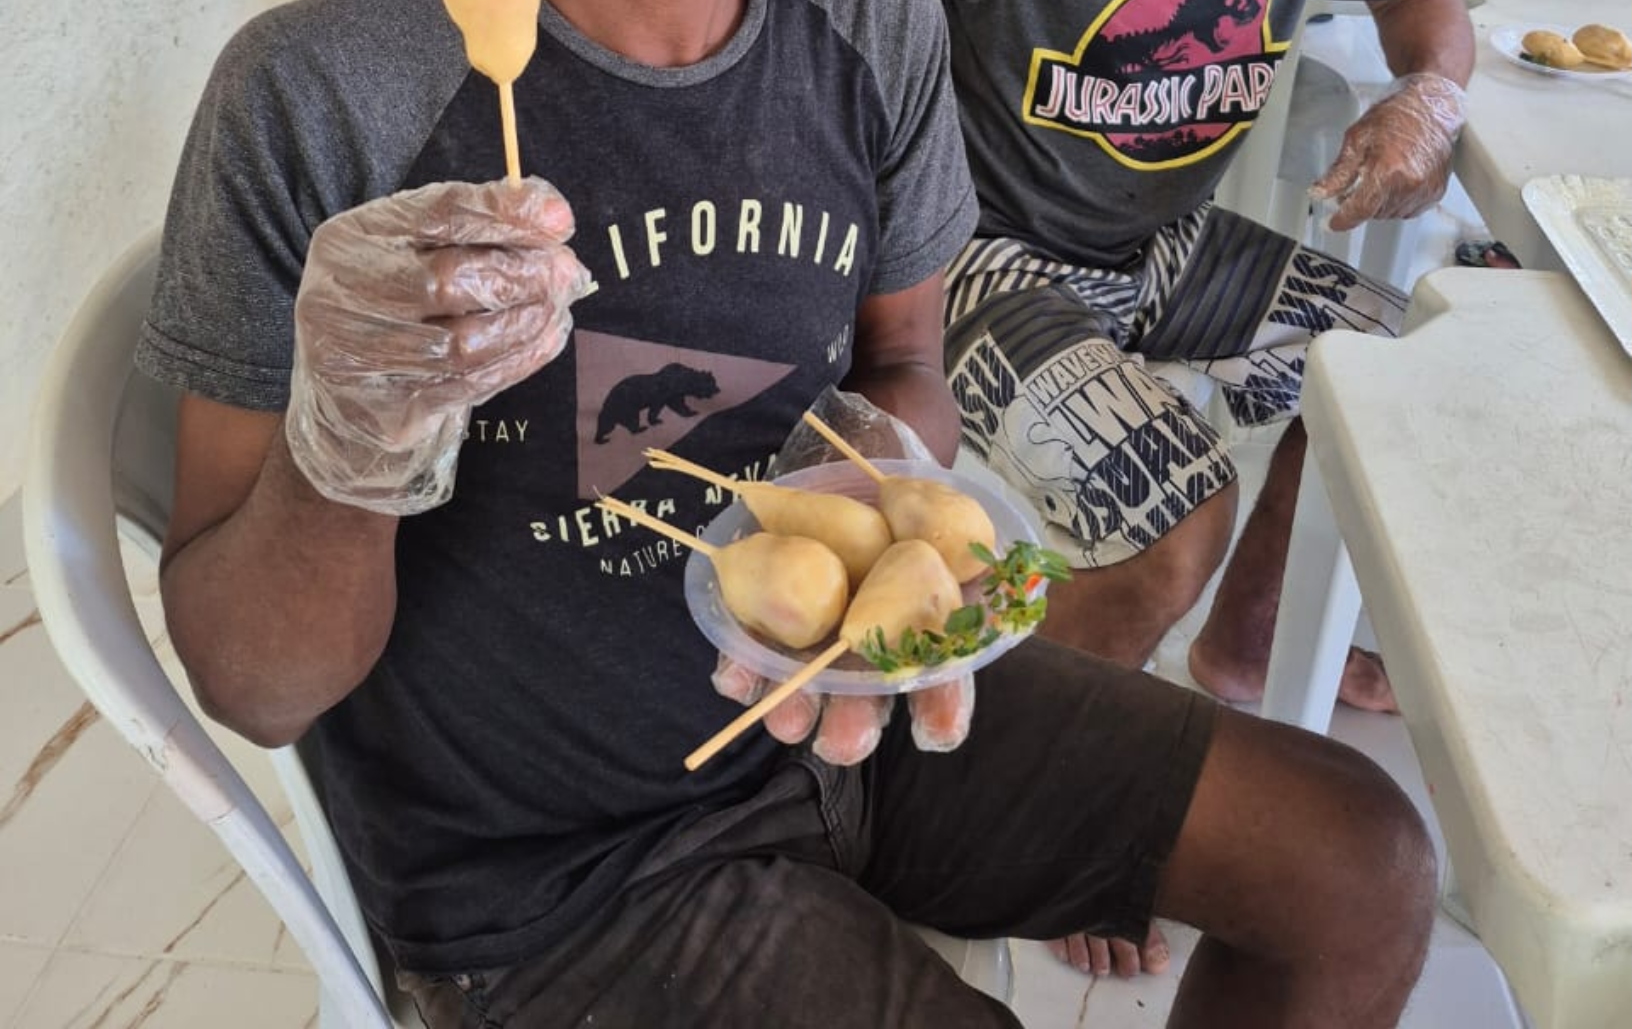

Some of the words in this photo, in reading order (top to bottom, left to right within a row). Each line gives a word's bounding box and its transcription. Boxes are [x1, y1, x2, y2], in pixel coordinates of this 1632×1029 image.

[1034, 64, 1197, 126] JURASSIC
[1196, 58, 1281, 121] PAR
[585, 198, 858, 296] IFORNIA
[600, 537, 683, 577] NATURE
